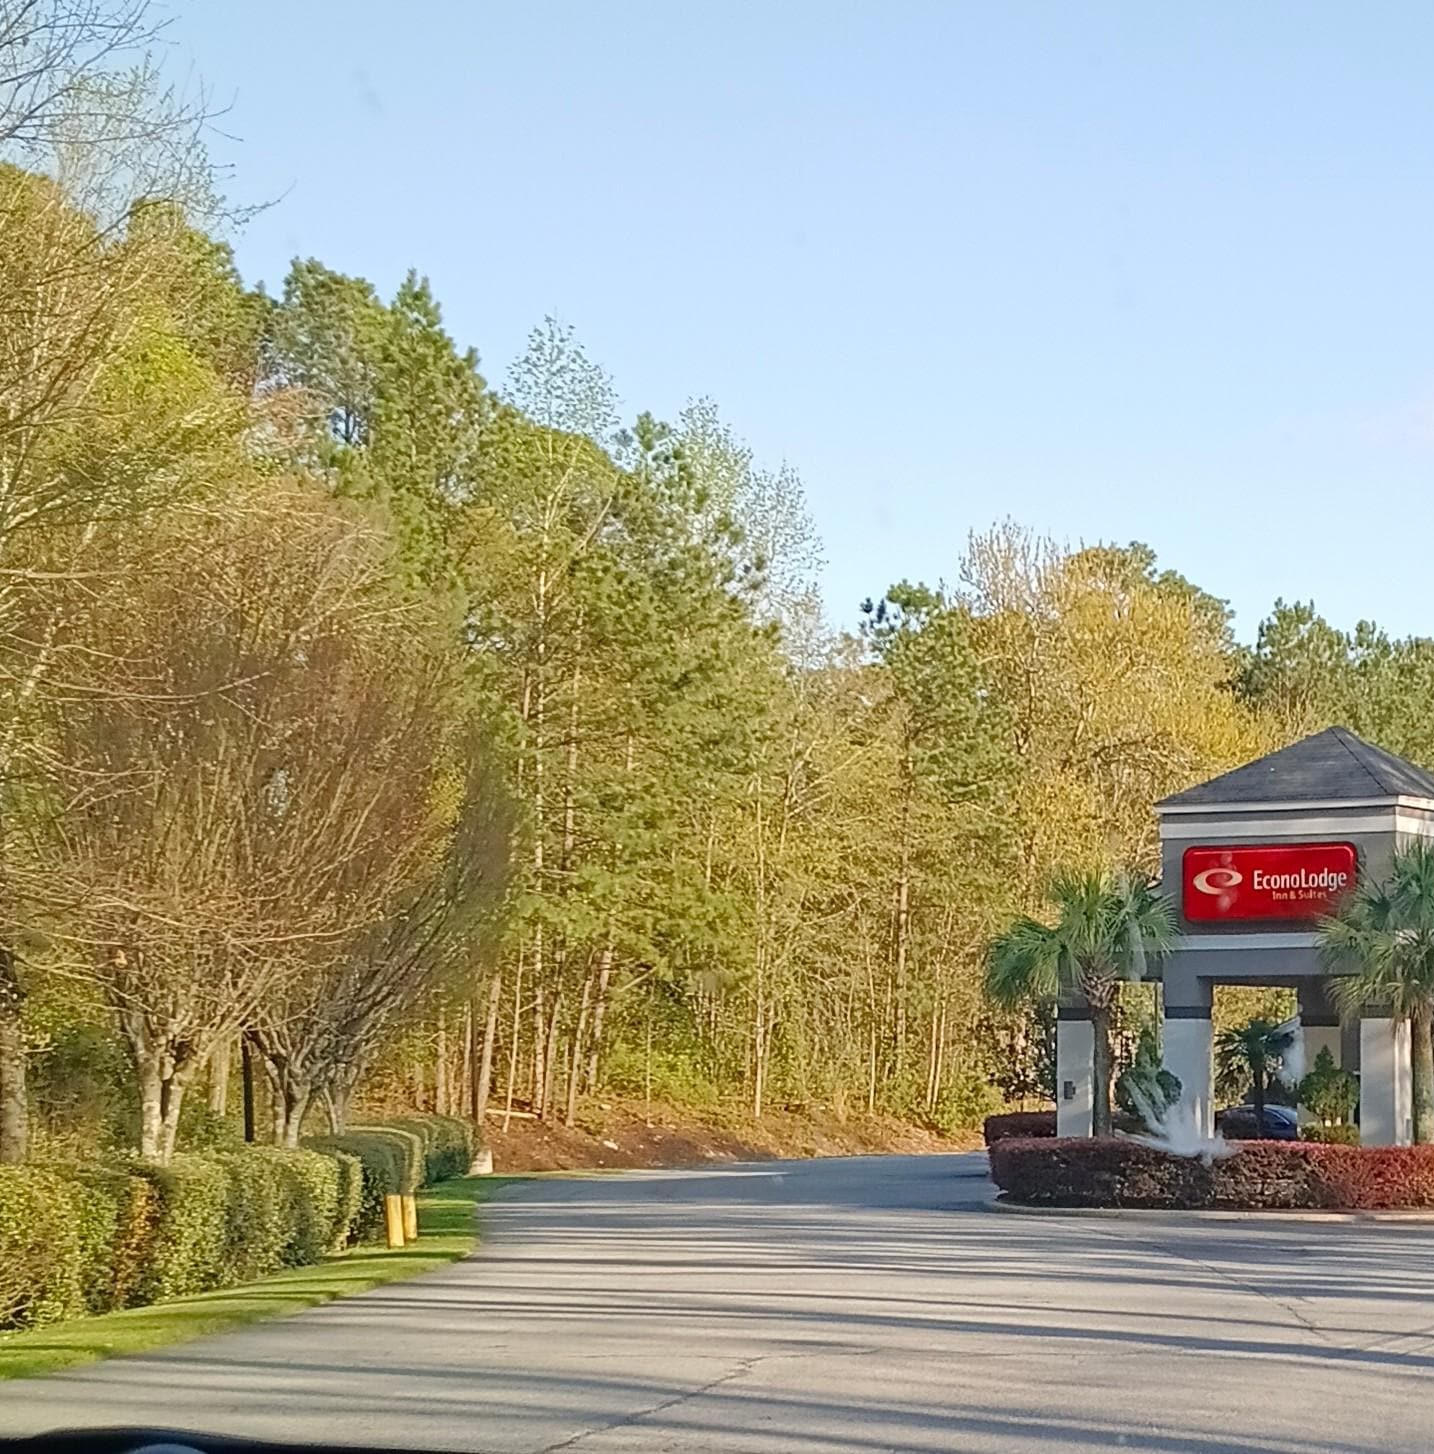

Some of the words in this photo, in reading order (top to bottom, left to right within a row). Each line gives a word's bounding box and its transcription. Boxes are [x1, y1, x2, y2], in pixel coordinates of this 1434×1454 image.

[1253, 868, 1347, 891] EconoLodge
[1272, 891, 1288, 900] Inn
[1289, 891, 1296, 900] &
[1298, 889, 1327, 899] Suites
